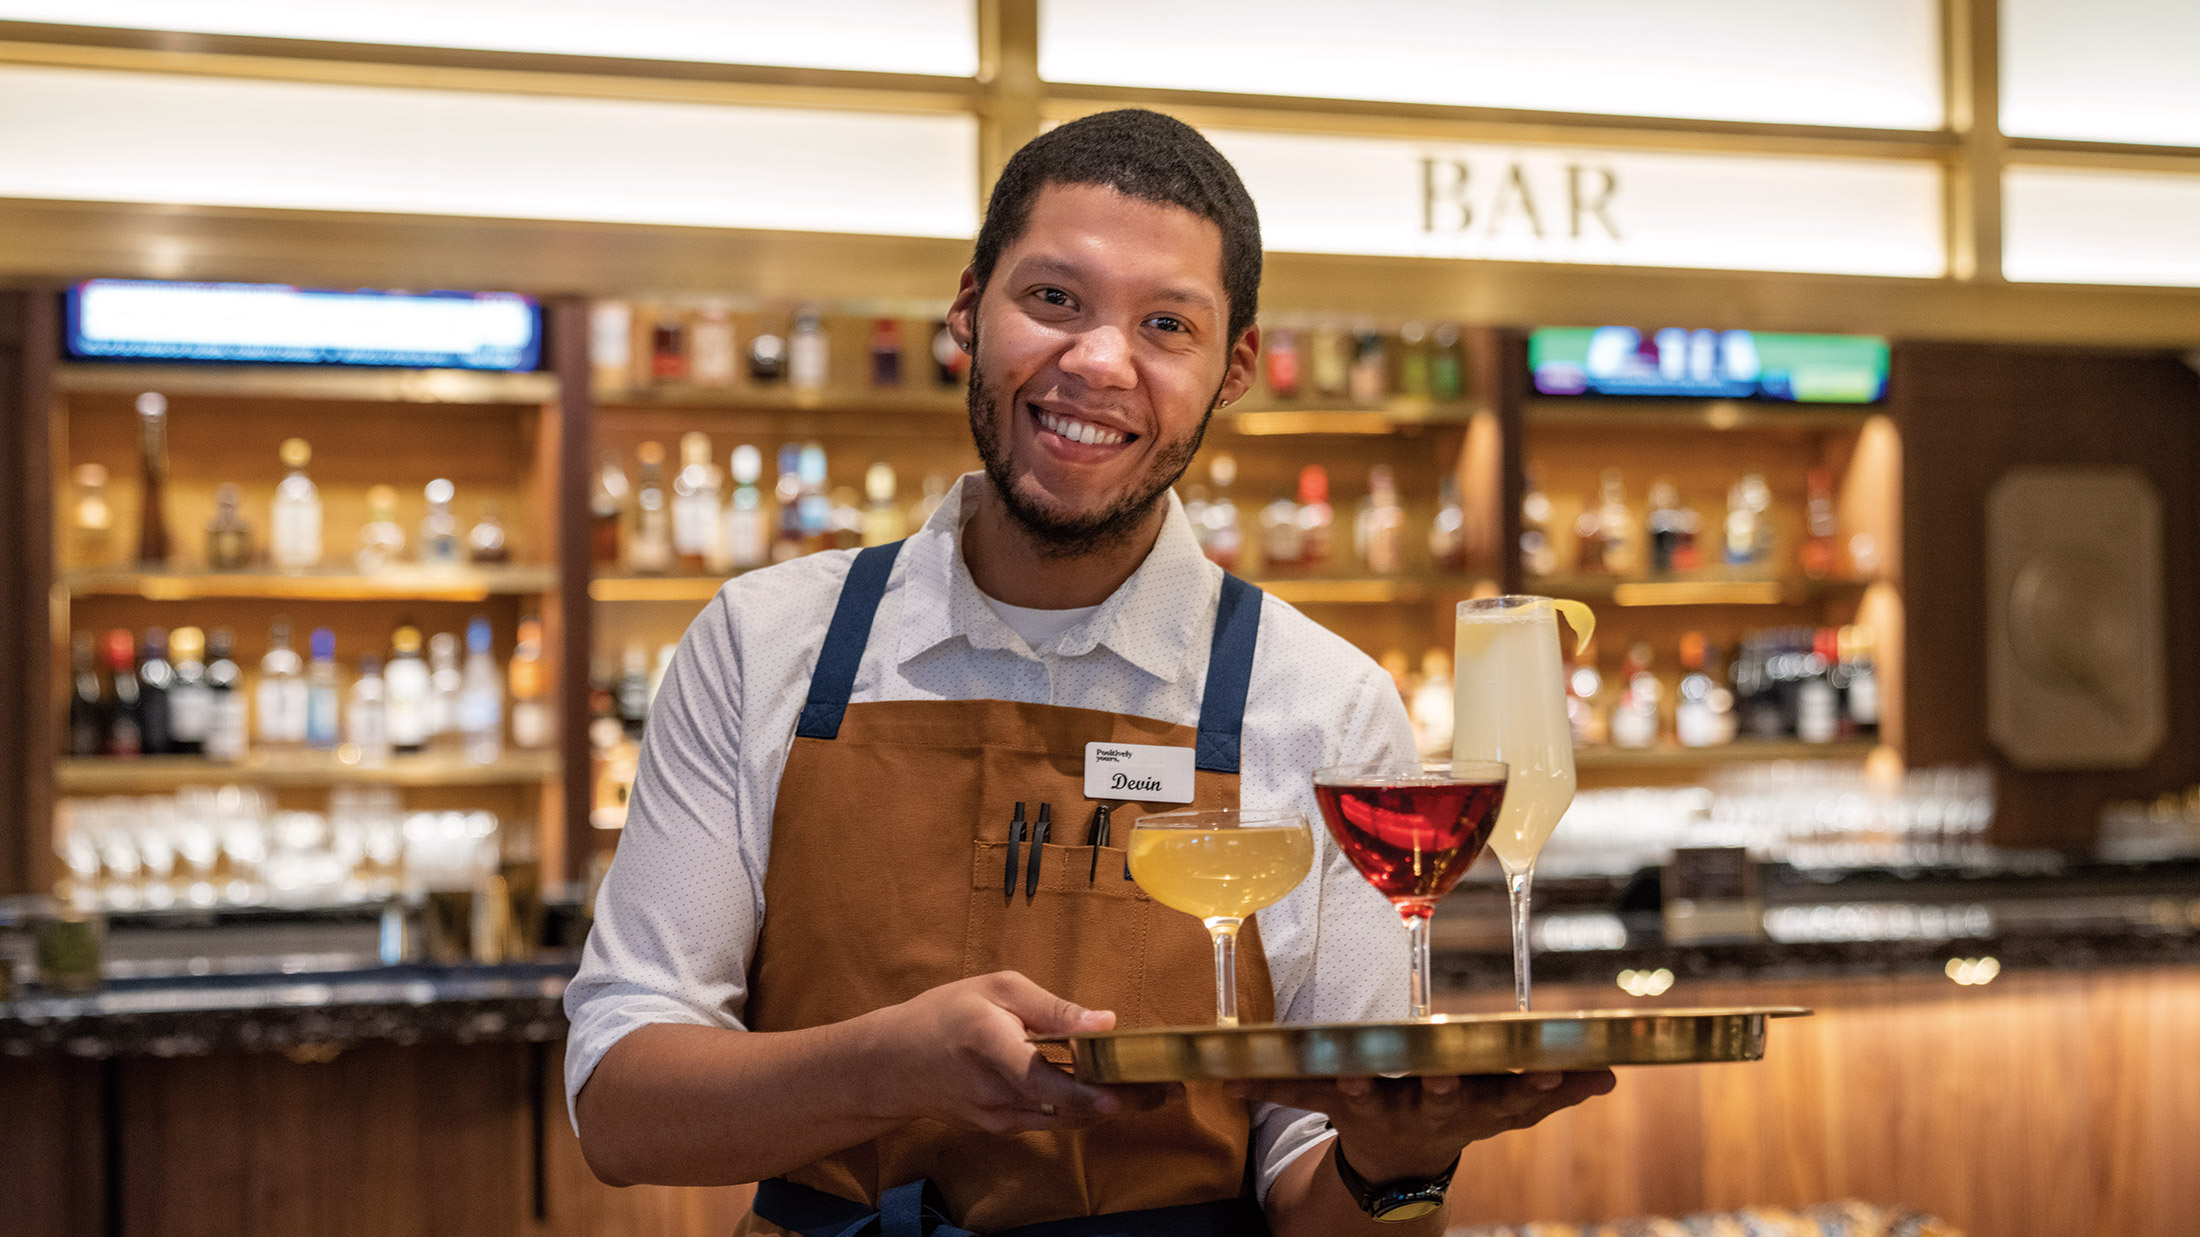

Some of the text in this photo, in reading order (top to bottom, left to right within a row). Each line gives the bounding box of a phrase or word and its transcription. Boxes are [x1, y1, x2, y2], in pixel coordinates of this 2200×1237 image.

[1419, 157, 1625, 242] BAR
[1096, 749, 1133, 759] Positively
[1111, 773, 1162, 791] Devin
